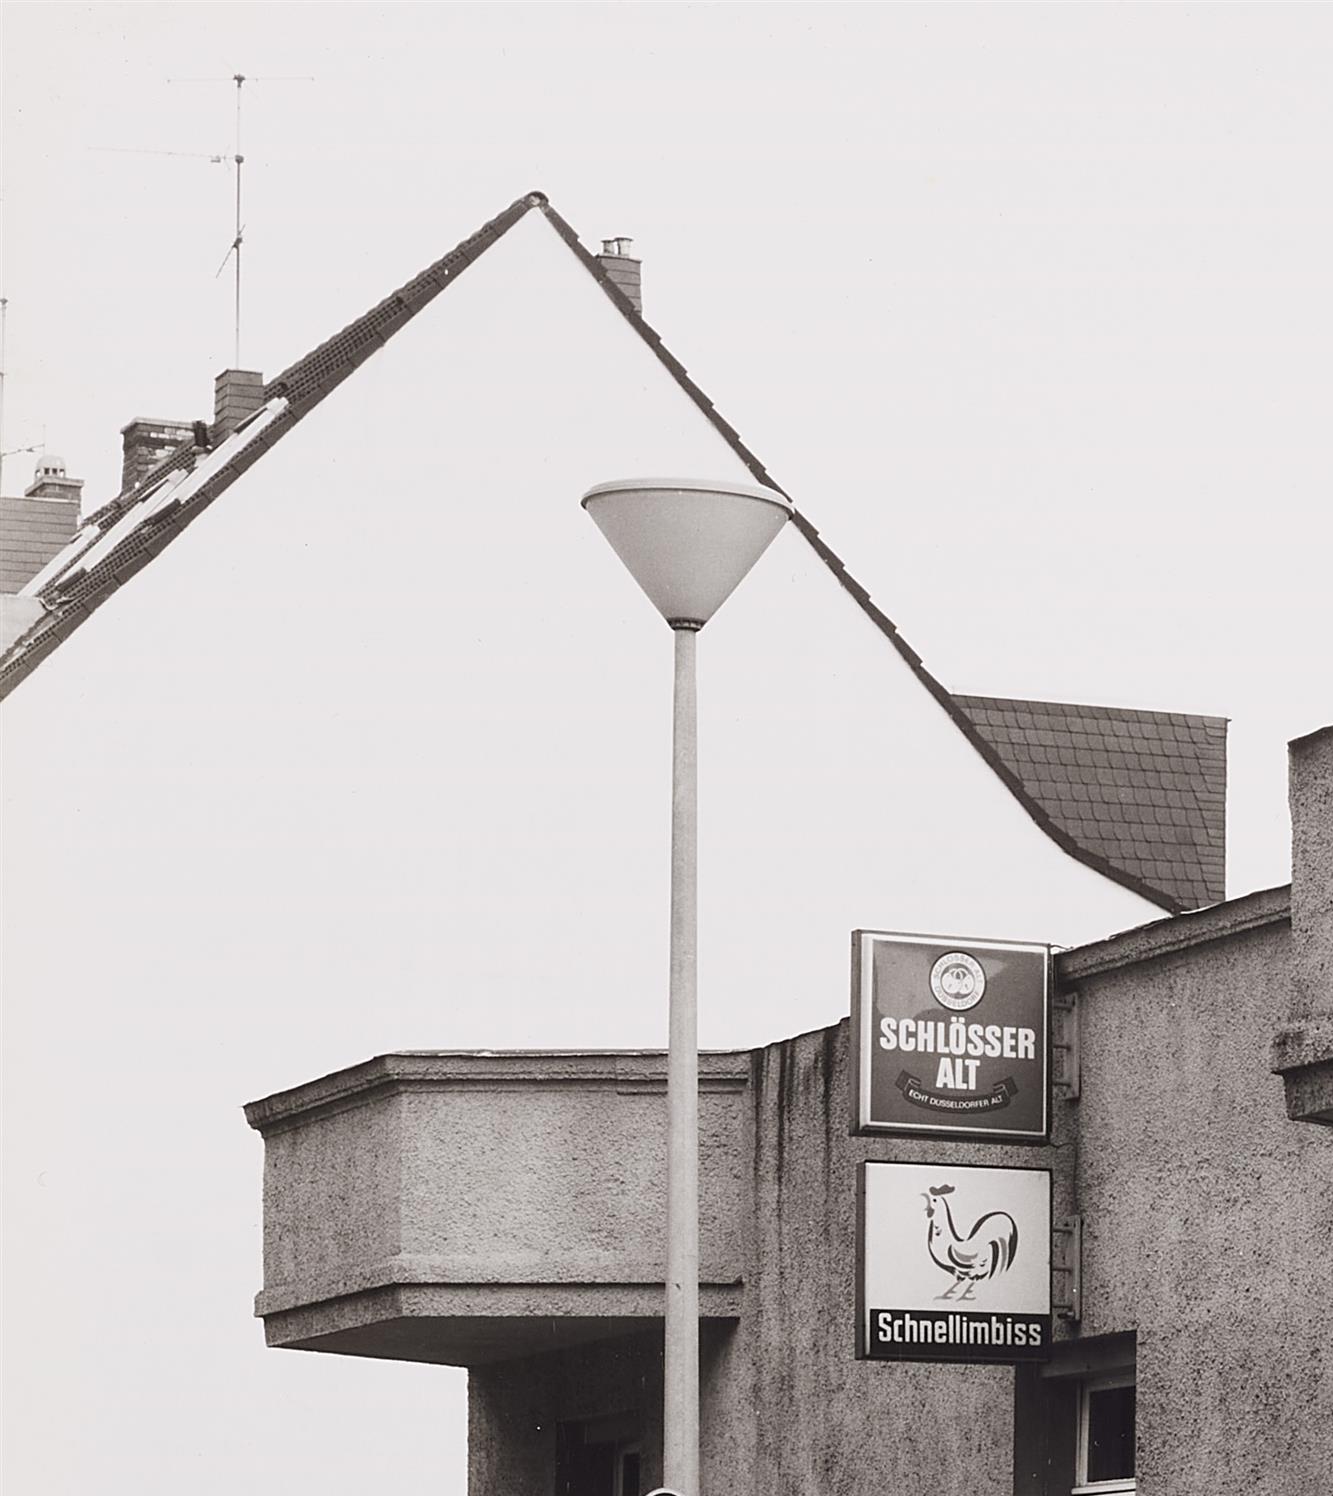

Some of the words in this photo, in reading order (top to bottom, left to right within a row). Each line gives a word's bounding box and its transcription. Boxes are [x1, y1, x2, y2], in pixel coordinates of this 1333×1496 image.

[879, 1015, 1036, 1060] SCHLÖSSER
[935, 1058, 981, 1091] ALT
[908, 1089, 928, 1102] ECHT
[991, 1095, 1003, 1104] ALT
[877, 1311, 1043, 1347] Schnellimbiss
